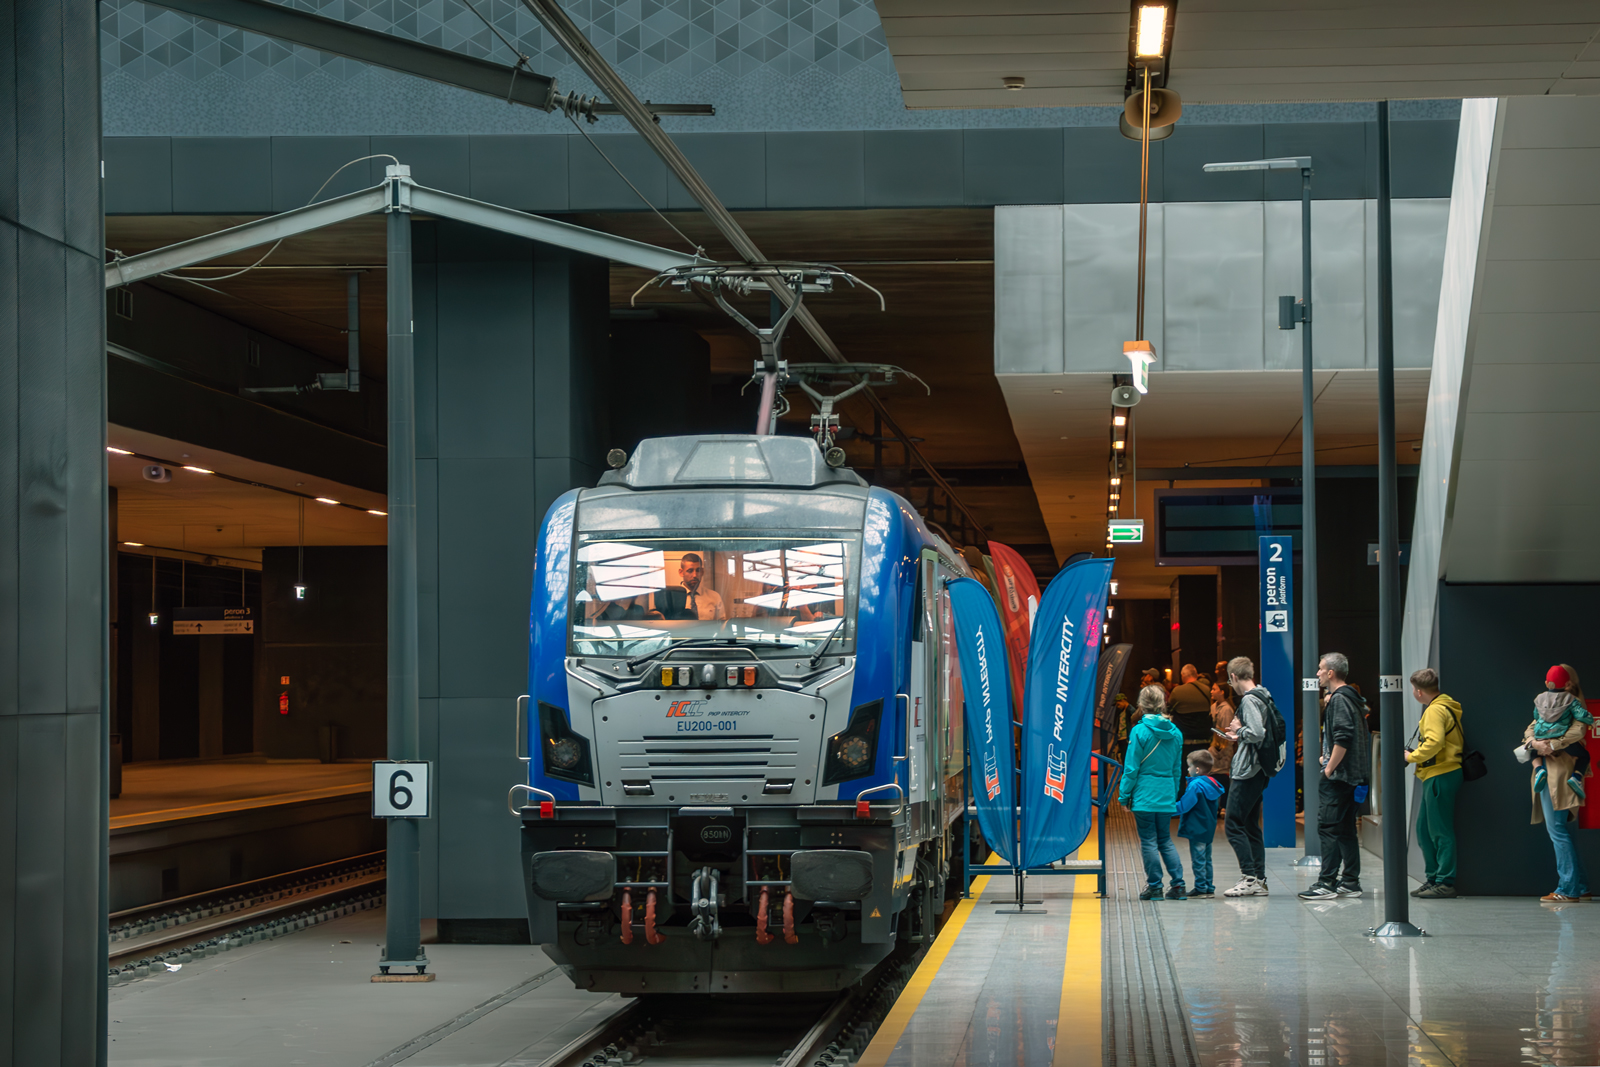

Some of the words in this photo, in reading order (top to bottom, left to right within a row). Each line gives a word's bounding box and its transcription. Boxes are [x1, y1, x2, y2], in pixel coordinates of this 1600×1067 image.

[1269, 543, 1283, 562] 2
[1266, 567, 1280, 606] peron
[1278, 575, 1288, 605] platform
[224, 608, 245, 616] peron
[245, 607, 251, 615] 3
[1056, 614, 1075, 703] INTERCITY
[677, 720, 737, 732] EU200-001
[1053, 703, 1064, 742] PKP
[389, 769, 414, 811] 6
